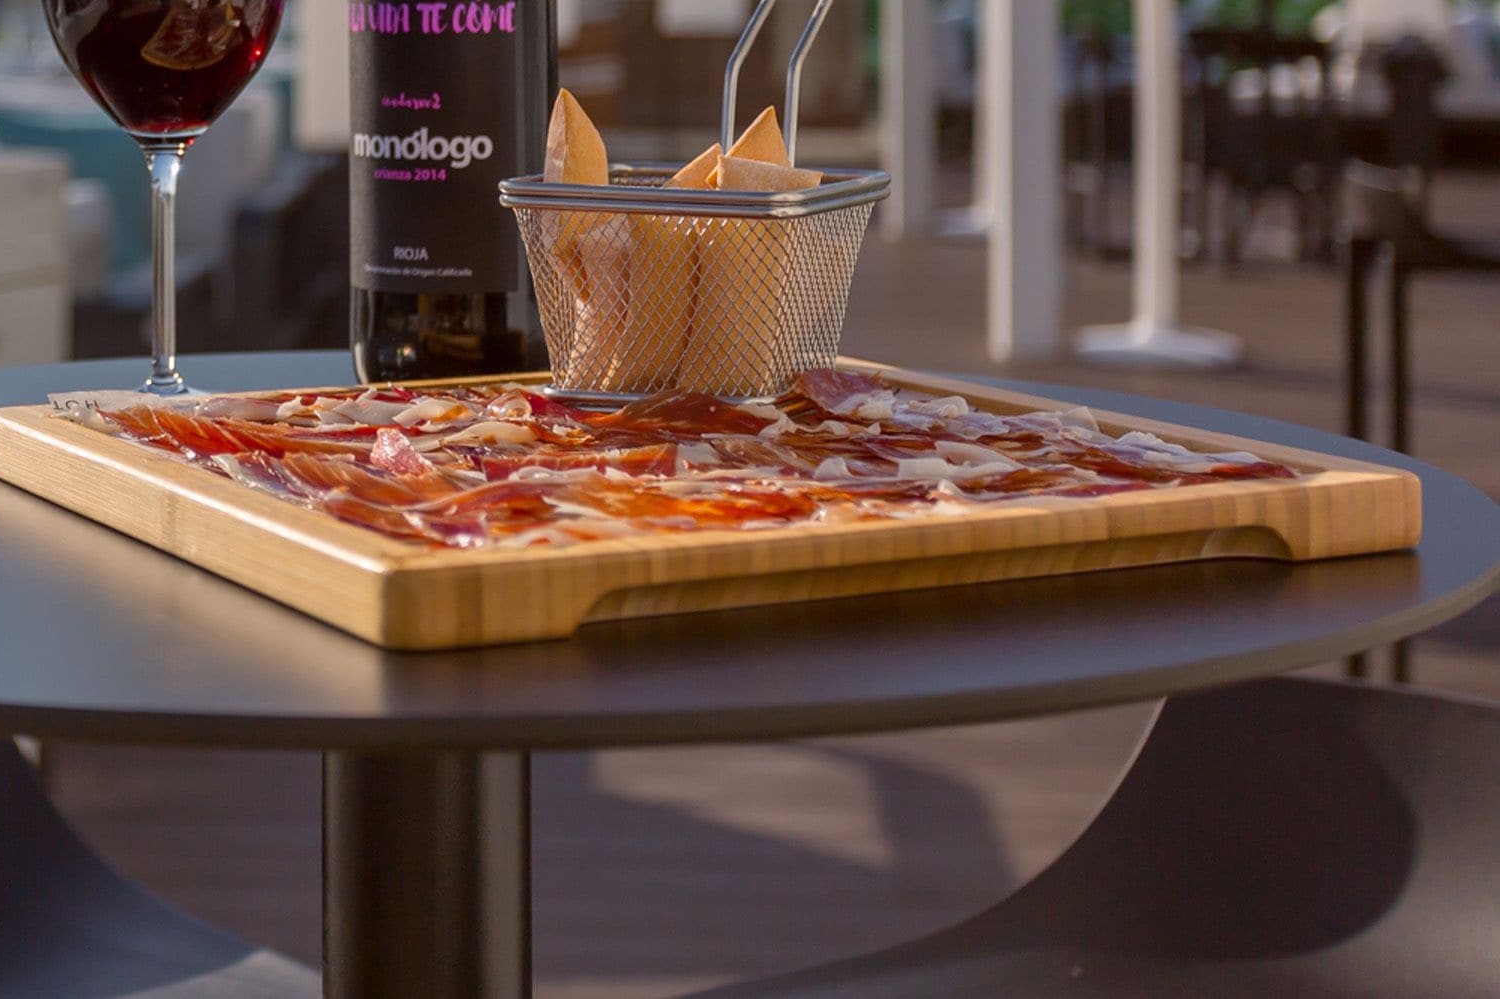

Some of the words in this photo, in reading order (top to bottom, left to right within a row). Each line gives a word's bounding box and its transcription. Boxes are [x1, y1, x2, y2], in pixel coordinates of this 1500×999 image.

[368, 1, 411, 35] VIDA
[416, 2, 450, 35] TE
[453, 1, 517, 35] COME
[354, 127, 494, 169] monólogo
[414, 168, 447, 181] 2014
[393, 246, 429, 261] RIOJA
